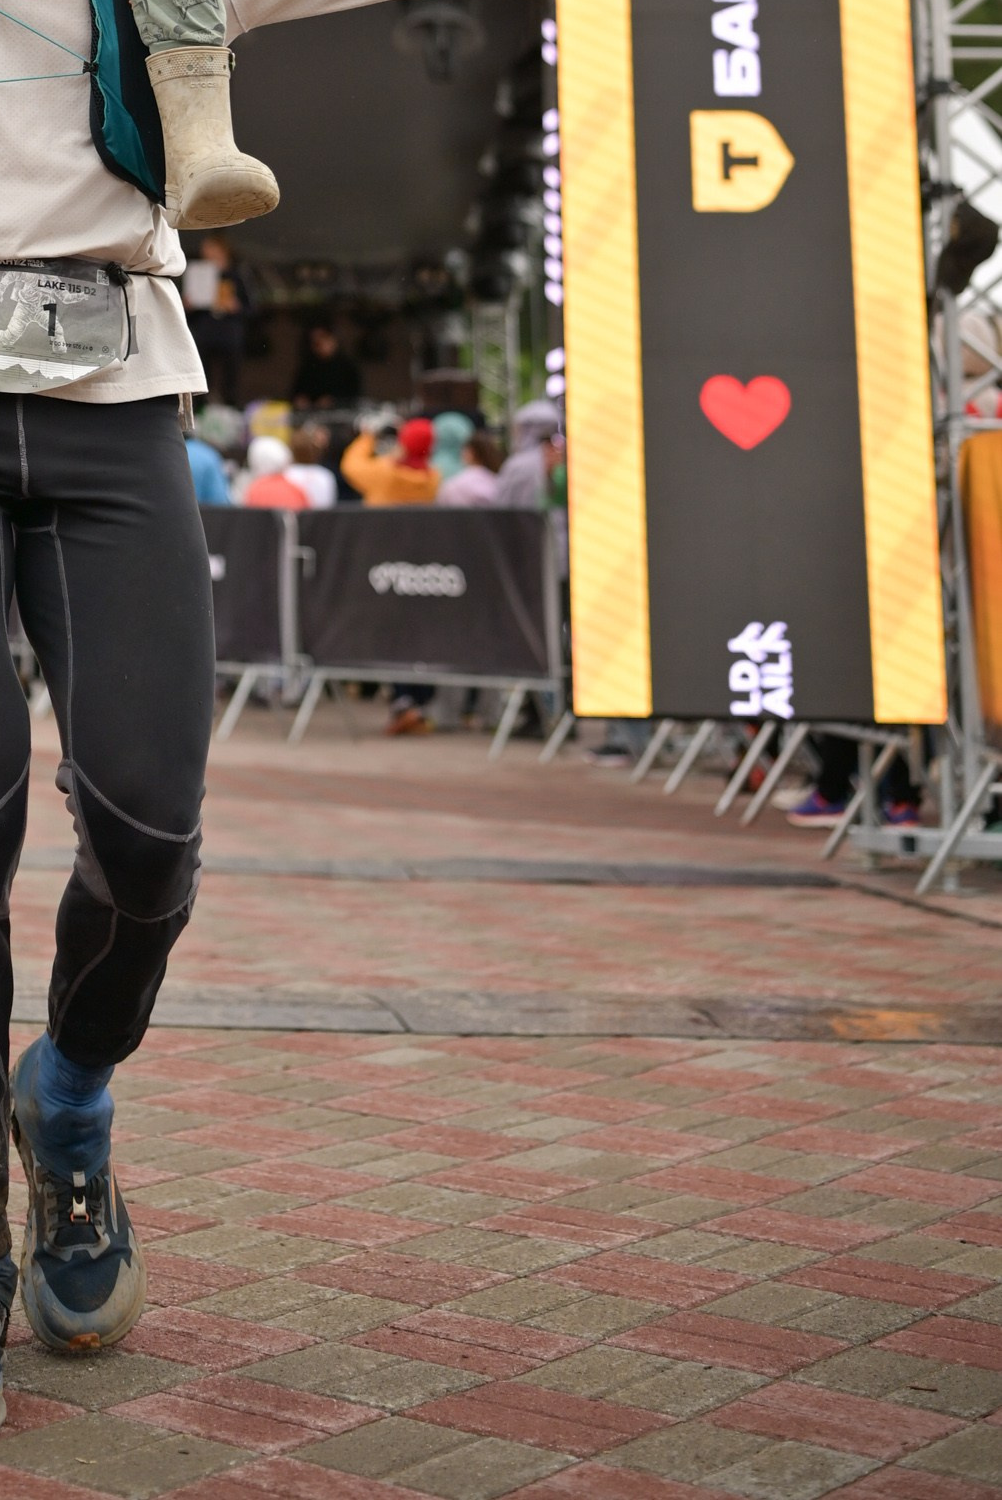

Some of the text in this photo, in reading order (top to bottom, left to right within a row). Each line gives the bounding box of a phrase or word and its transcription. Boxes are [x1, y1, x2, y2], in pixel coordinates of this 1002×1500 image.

[38, 279, 96, 296] LAKE 115 D2
[43, 303, 57, 337] 1
